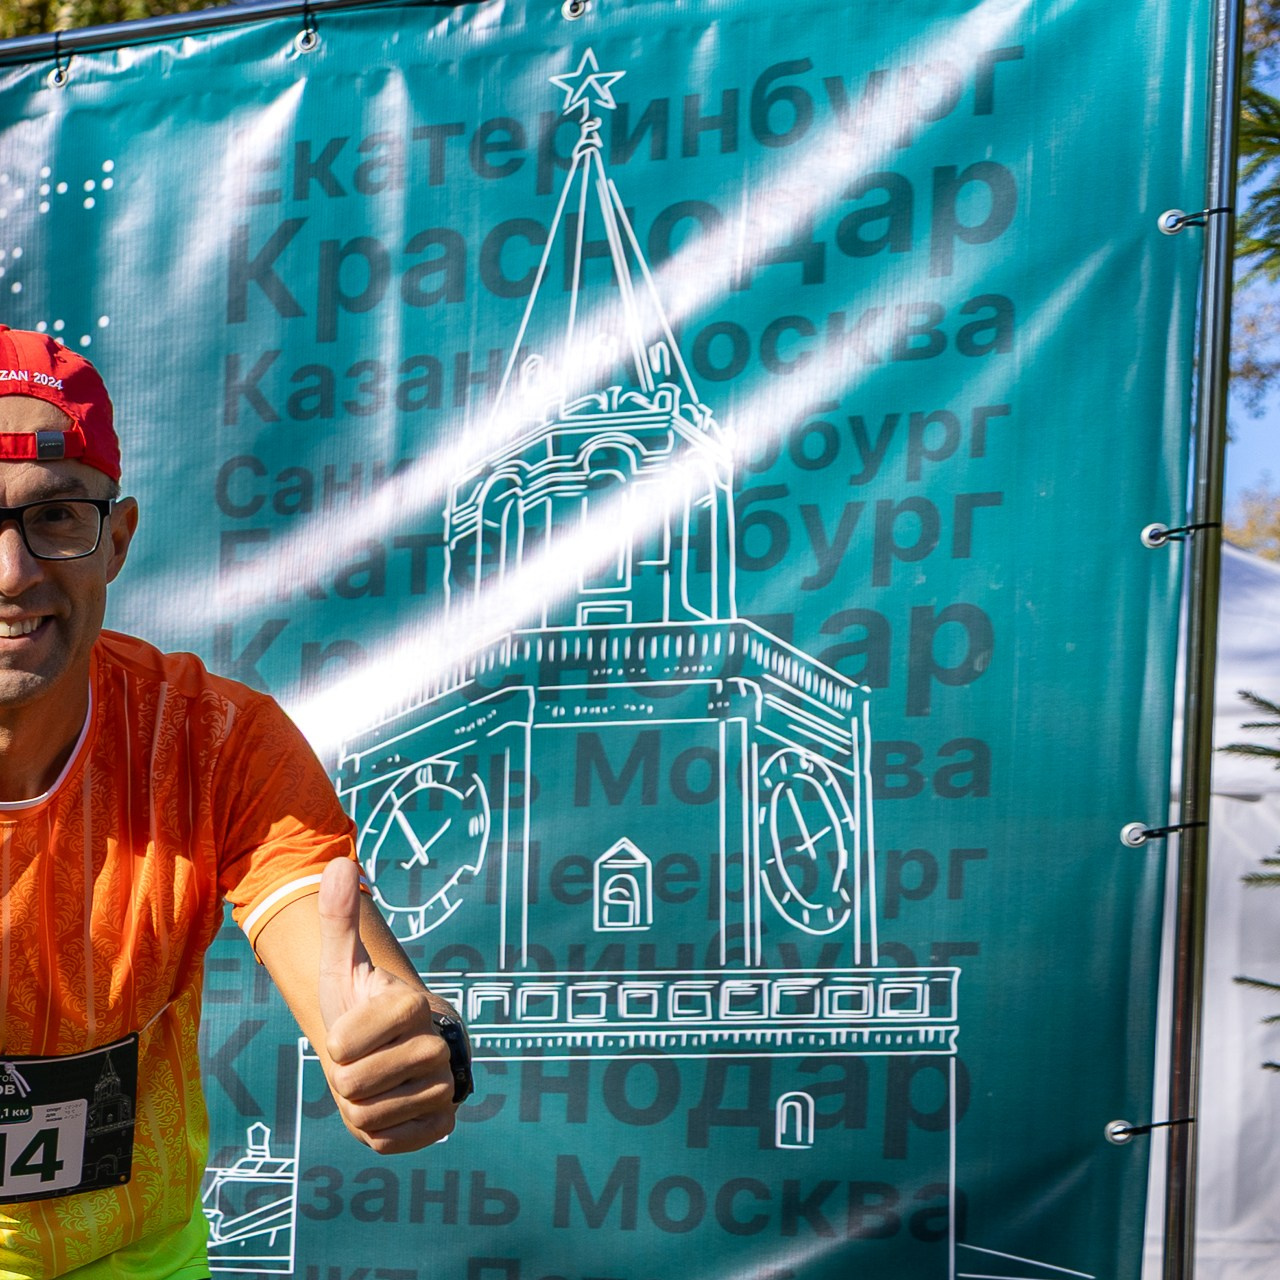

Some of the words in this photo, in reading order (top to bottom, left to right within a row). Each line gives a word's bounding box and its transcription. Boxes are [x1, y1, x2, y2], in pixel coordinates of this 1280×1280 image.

[33, 372, 63, 390] 2024
[221, 346, 510, 428] Казан
[553, 1154, 968, 1246] Москва
